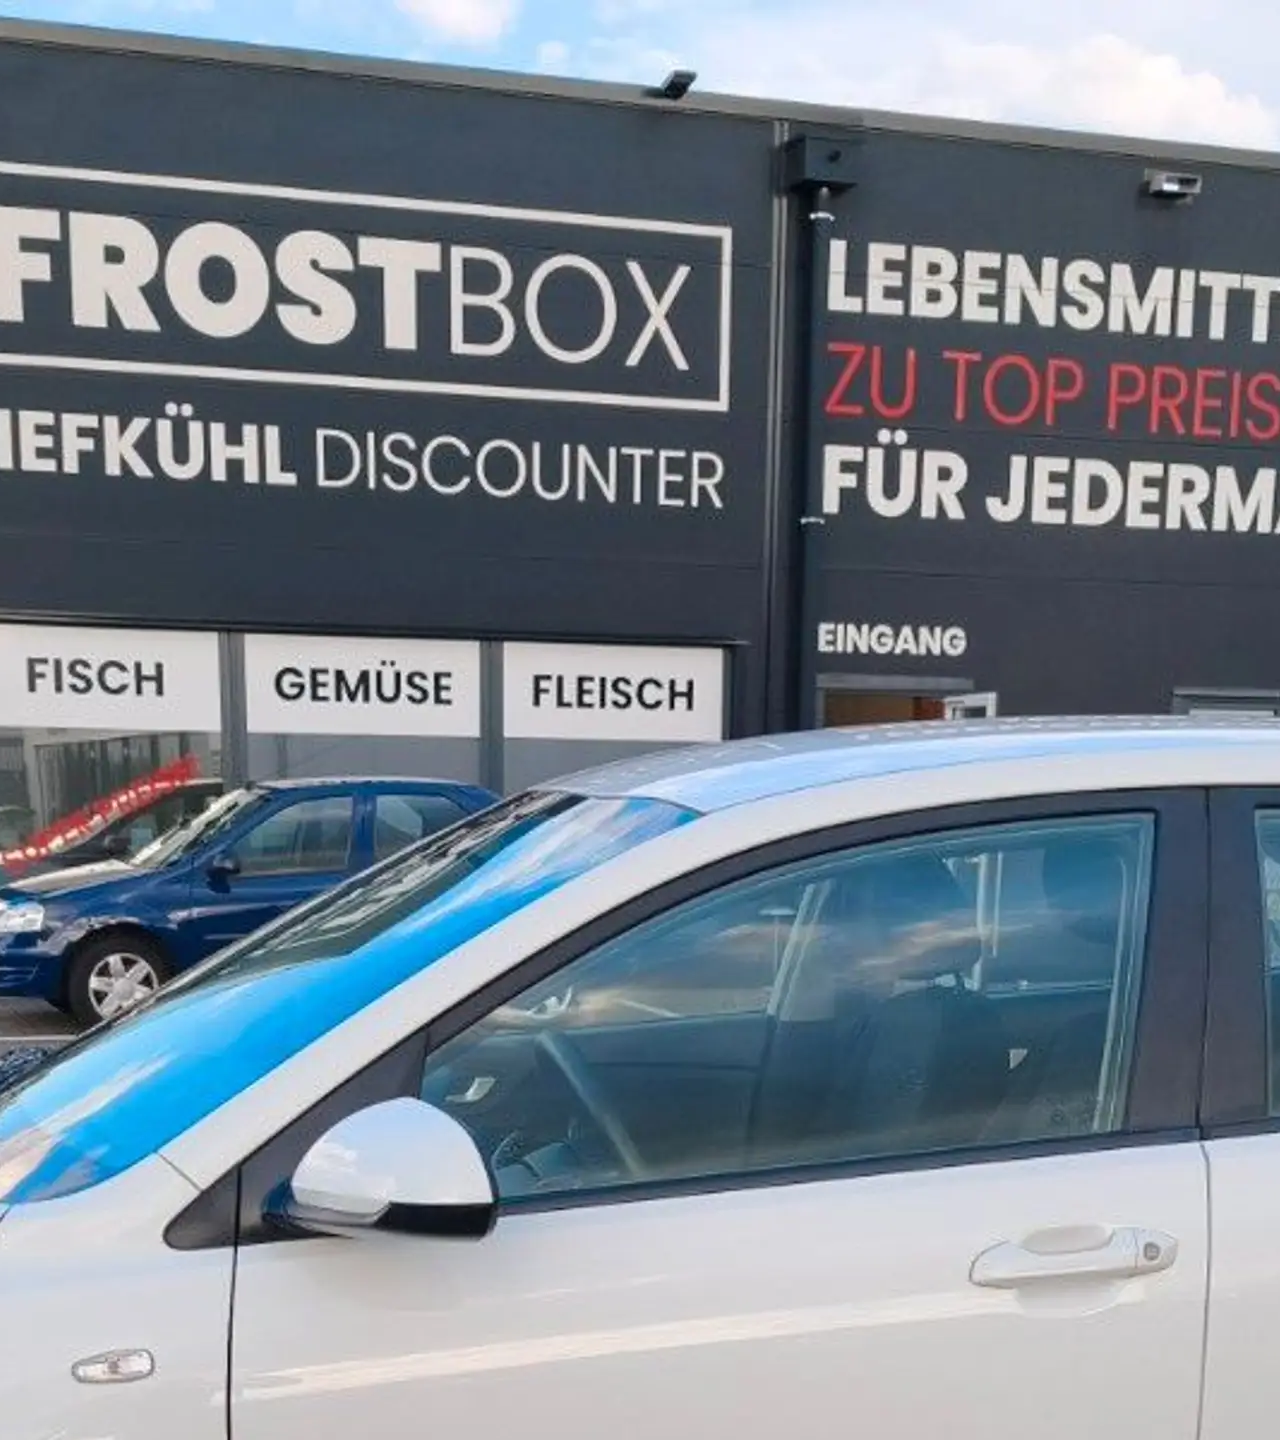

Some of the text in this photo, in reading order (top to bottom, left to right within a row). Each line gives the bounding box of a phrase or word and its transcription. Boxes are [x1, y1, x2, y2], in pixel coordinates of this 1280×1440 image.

[823, 341, 917, 420] ZU
[942, 349, 1086, 426] TOP
[315, 427, 724, 509] DISCOUNTER
[822, 427, 968, 520] FÜR
[816, 621, 967, 657] EINGANG
[26, 657, 166, 697] FISCH
[274, 661, 454, 707] GEMÜSE
[531, 673, 696, 712] FLEISCH
